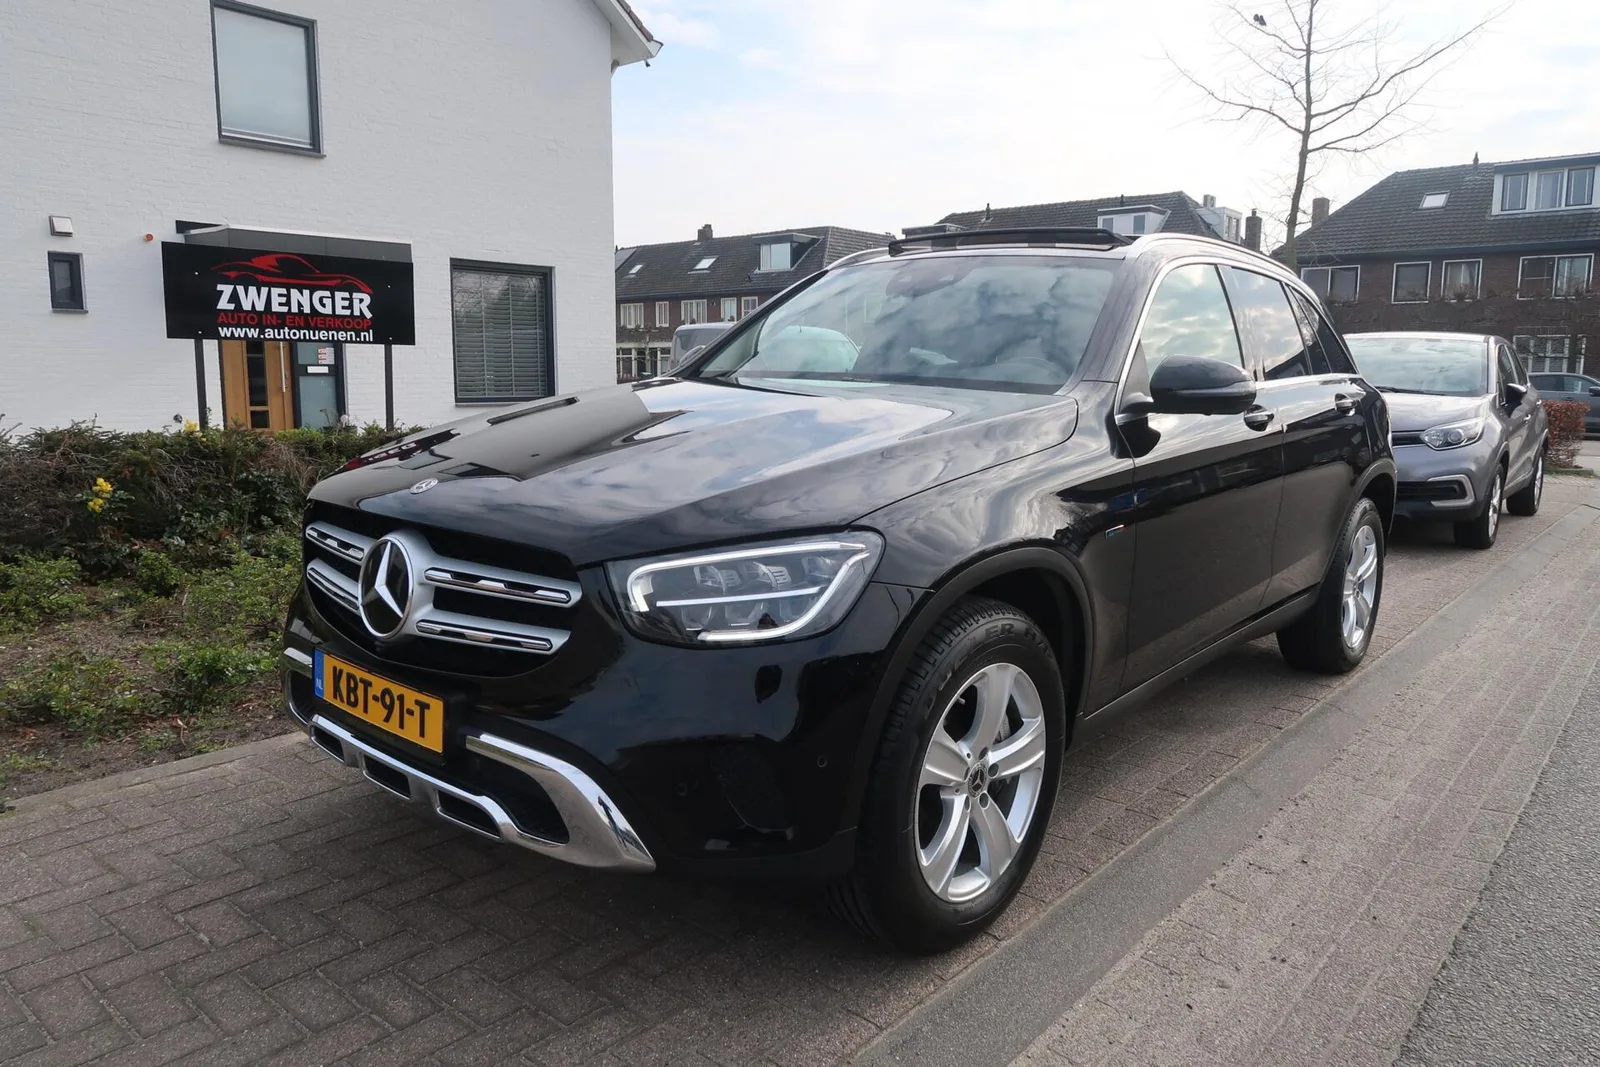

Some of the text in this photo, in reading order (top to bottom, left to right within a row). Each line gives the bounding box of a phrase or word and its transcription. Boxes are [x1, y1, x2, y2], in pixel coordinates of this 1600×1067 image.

[216, 283, 373, 319] ZWENGER
[217, 312, 372, 330] AUTO IN- EN VERKOOP
[218, 326, 373, 342] www.autonuenen.nl
[332, 665, 431, 739] KBT-91-T
